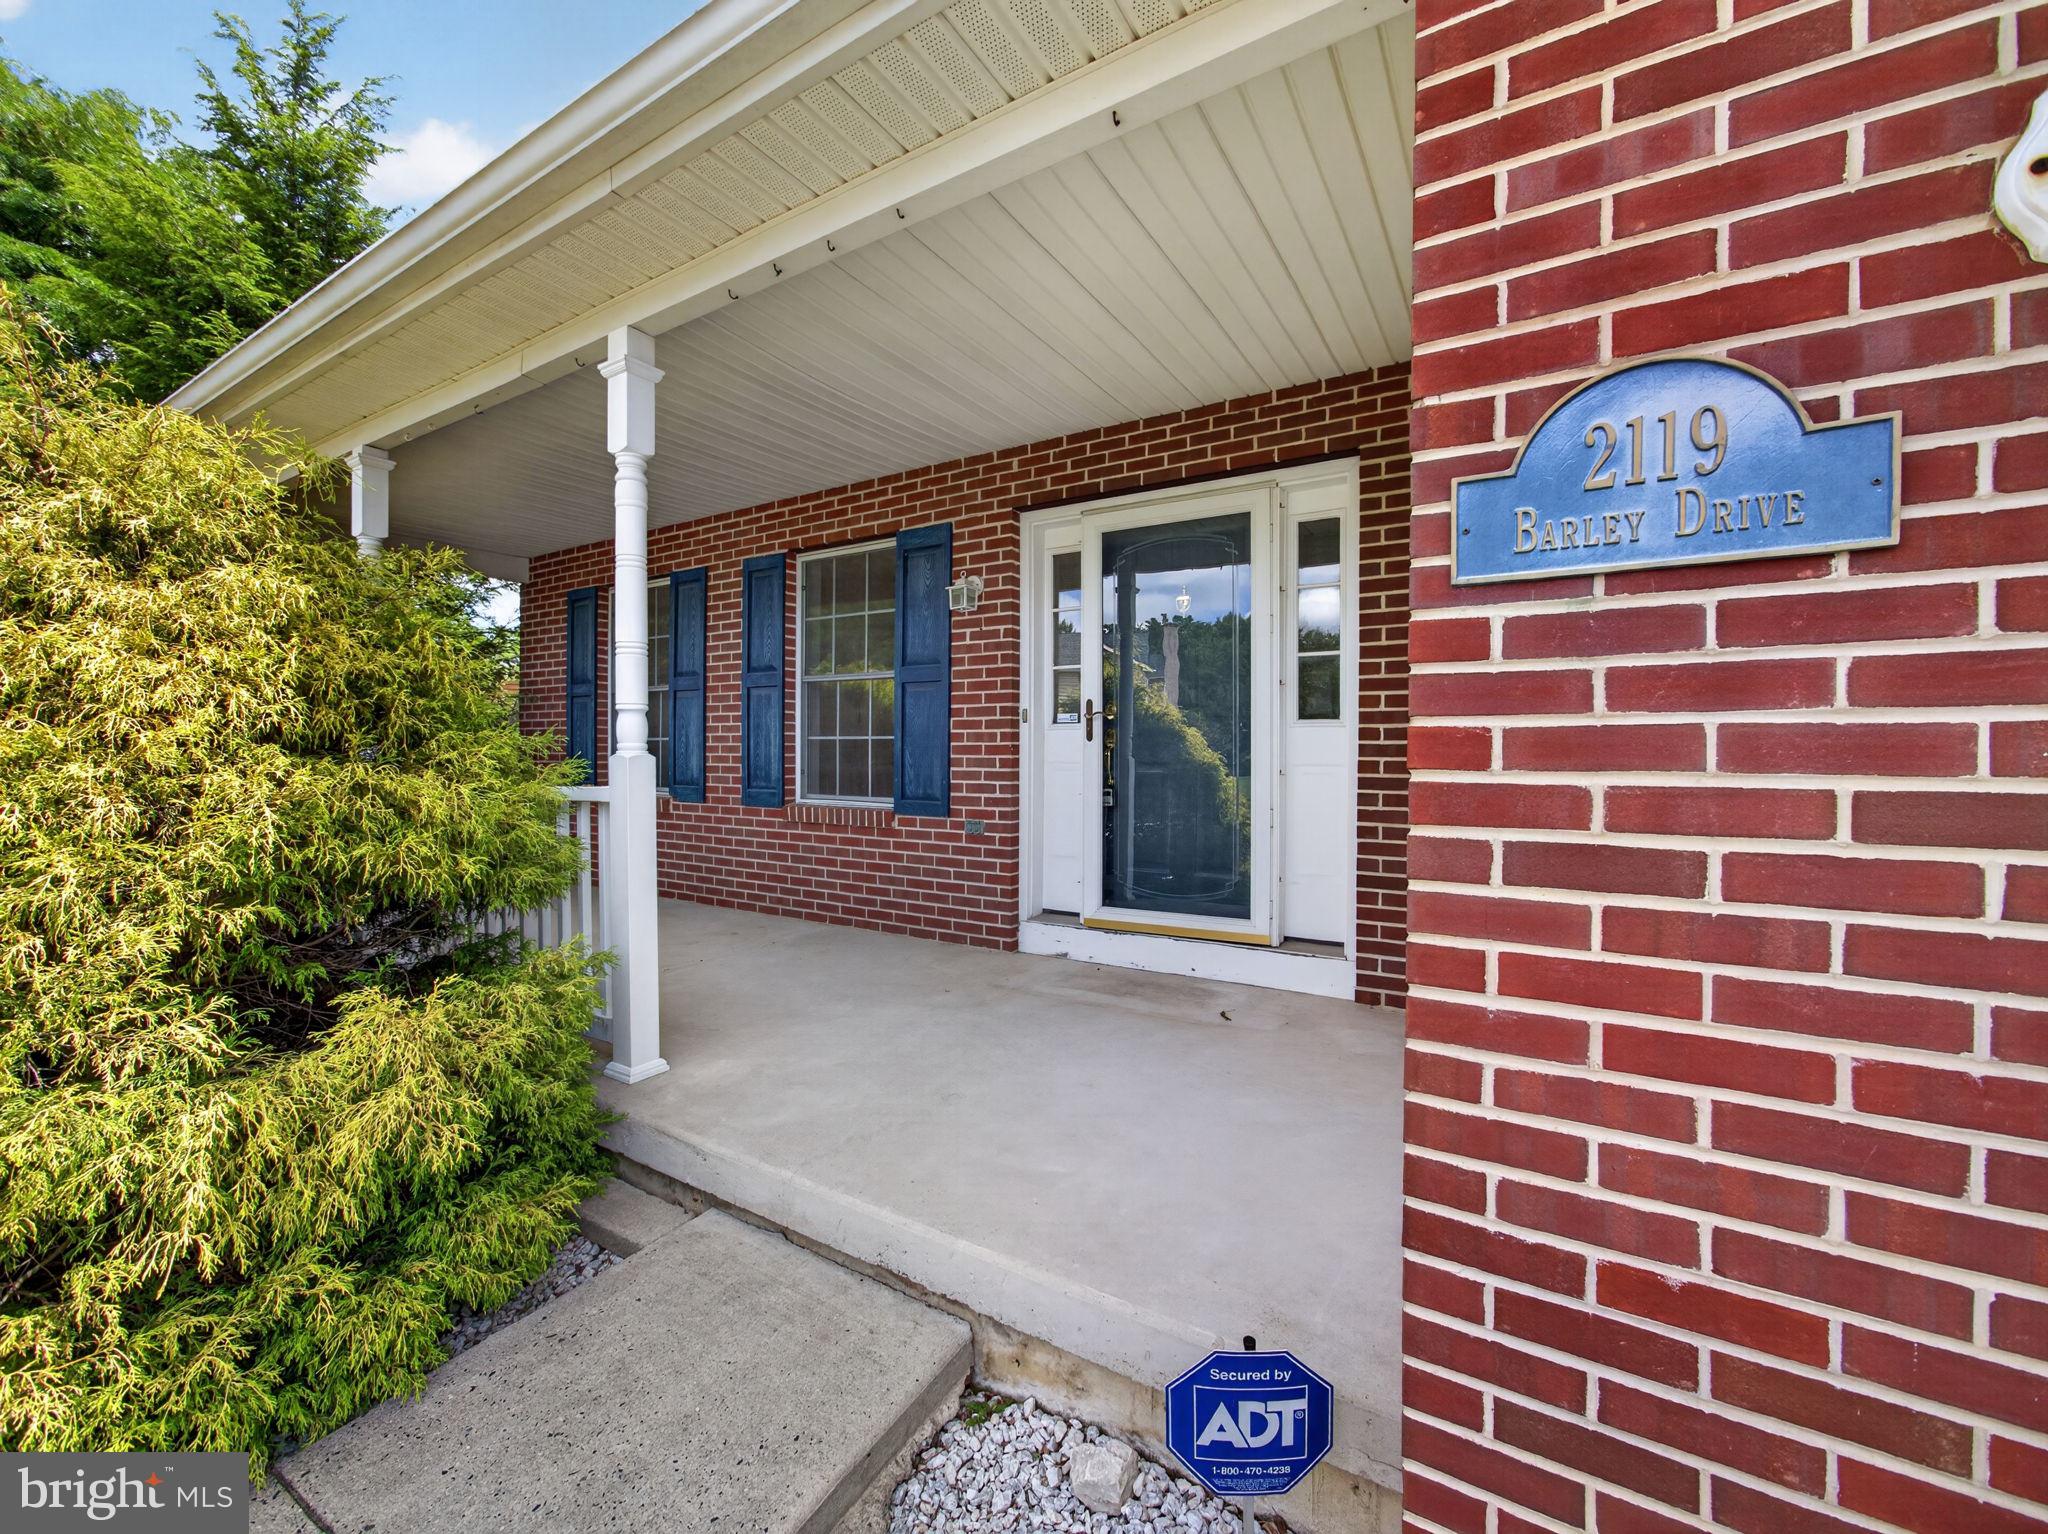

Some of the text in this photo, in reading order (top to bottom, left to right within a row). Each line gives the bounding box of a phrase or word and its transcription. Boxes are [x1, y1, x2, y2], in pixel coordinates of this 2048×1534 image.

[1583, 404, 1729, 492] 2119
[1513, 487, 1806, 554] BARLEY DRIVE
[1210, 1368, 1292, 1382] Secured by
[1196, 1398, 1307, 1448] ADT
